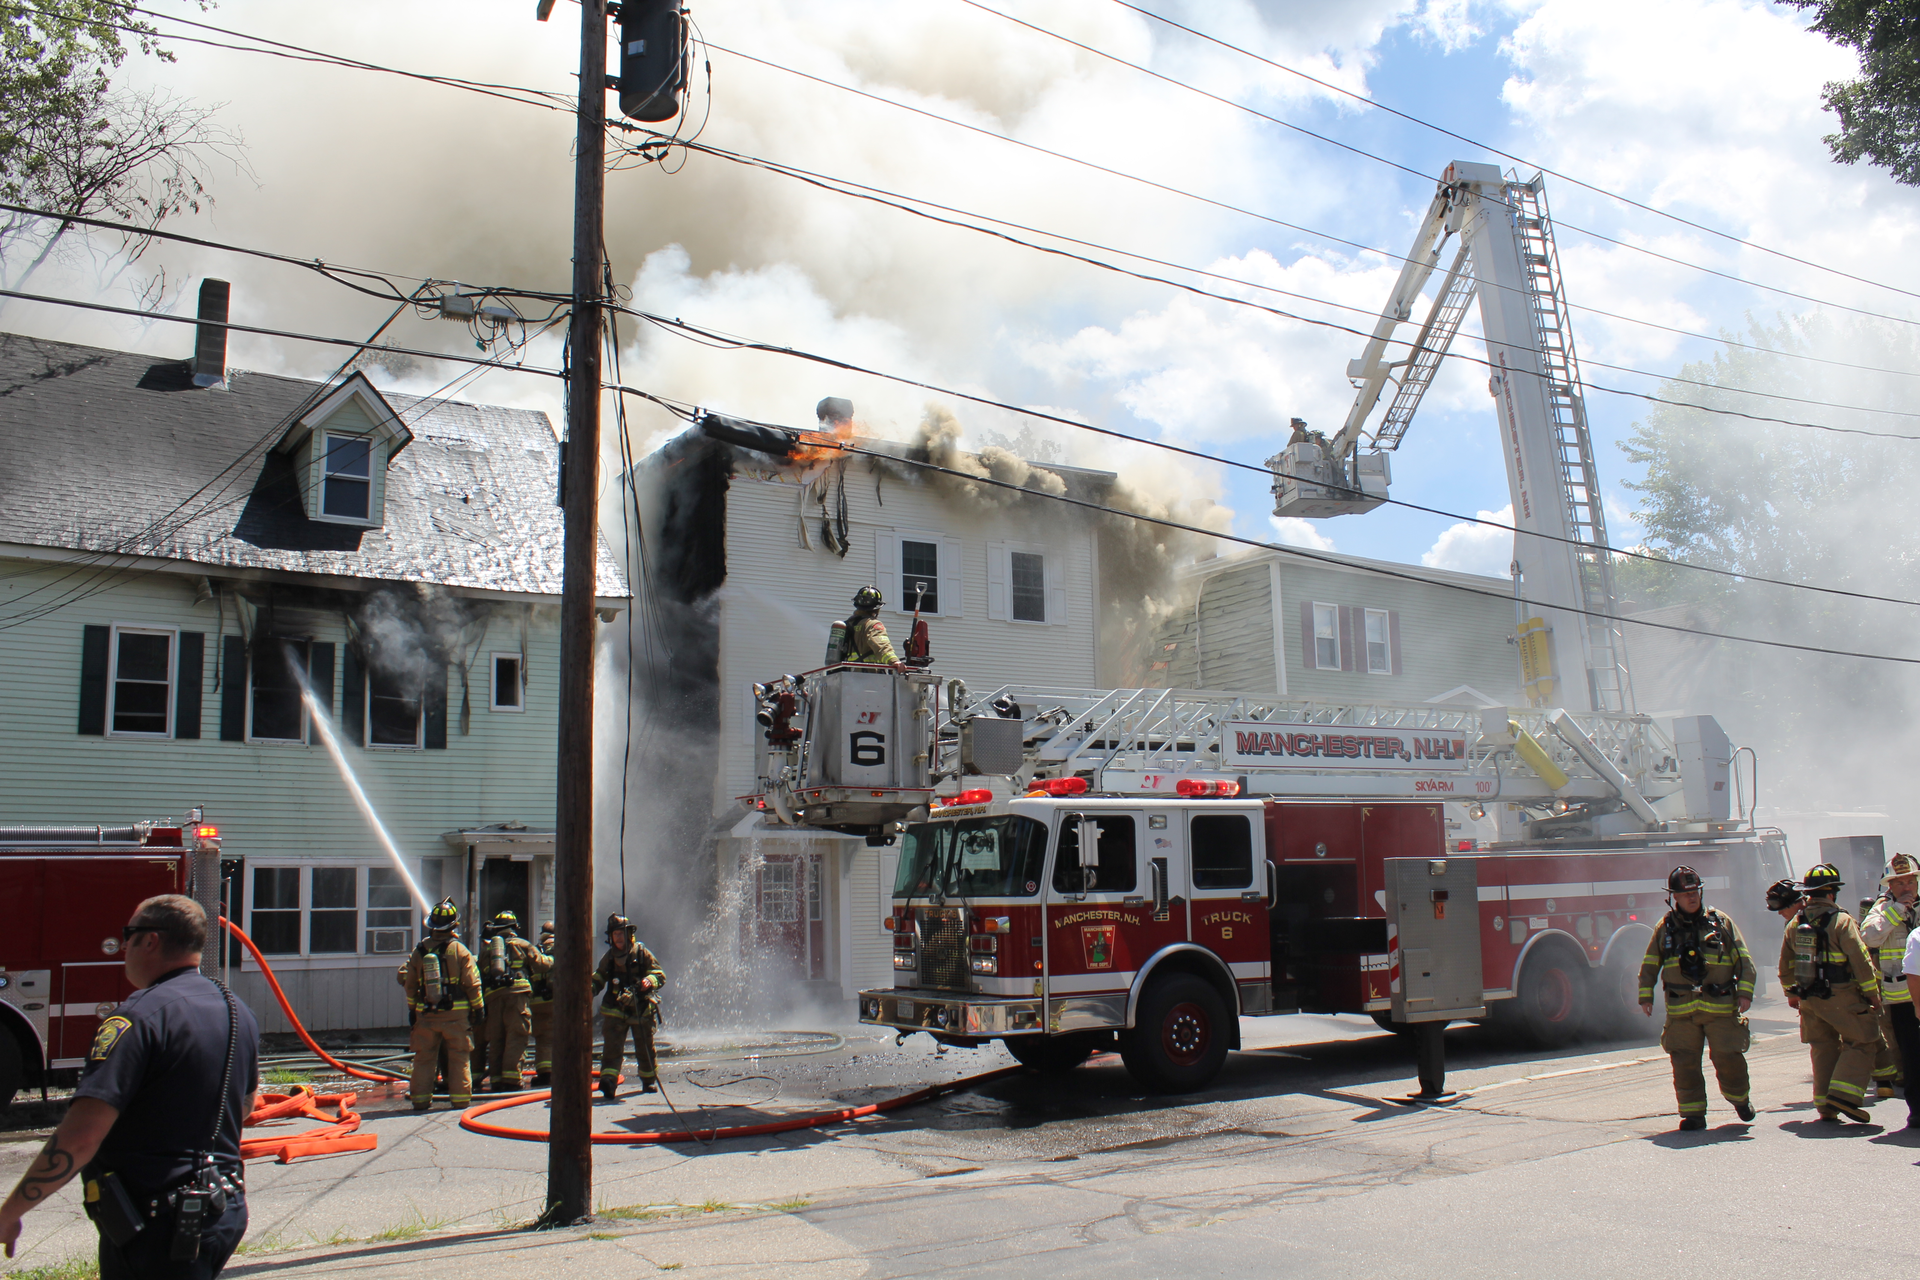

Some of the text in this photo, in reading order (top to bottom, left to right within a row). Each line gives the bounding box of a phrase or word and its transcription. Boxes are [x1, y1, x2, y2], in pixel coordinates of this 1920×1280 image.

[850, 731, 885, 767] 6
[1234, 730, 1455, 763] MANCHESTER, N.H.
[1415, 778, 1454, 792] SKYARM
[1054, 910, 1141, 929] MANCHESTER, N.H.
[1200, 911, 1253, 926] TRUCK
[1221, 926, 1233, 940] 6
